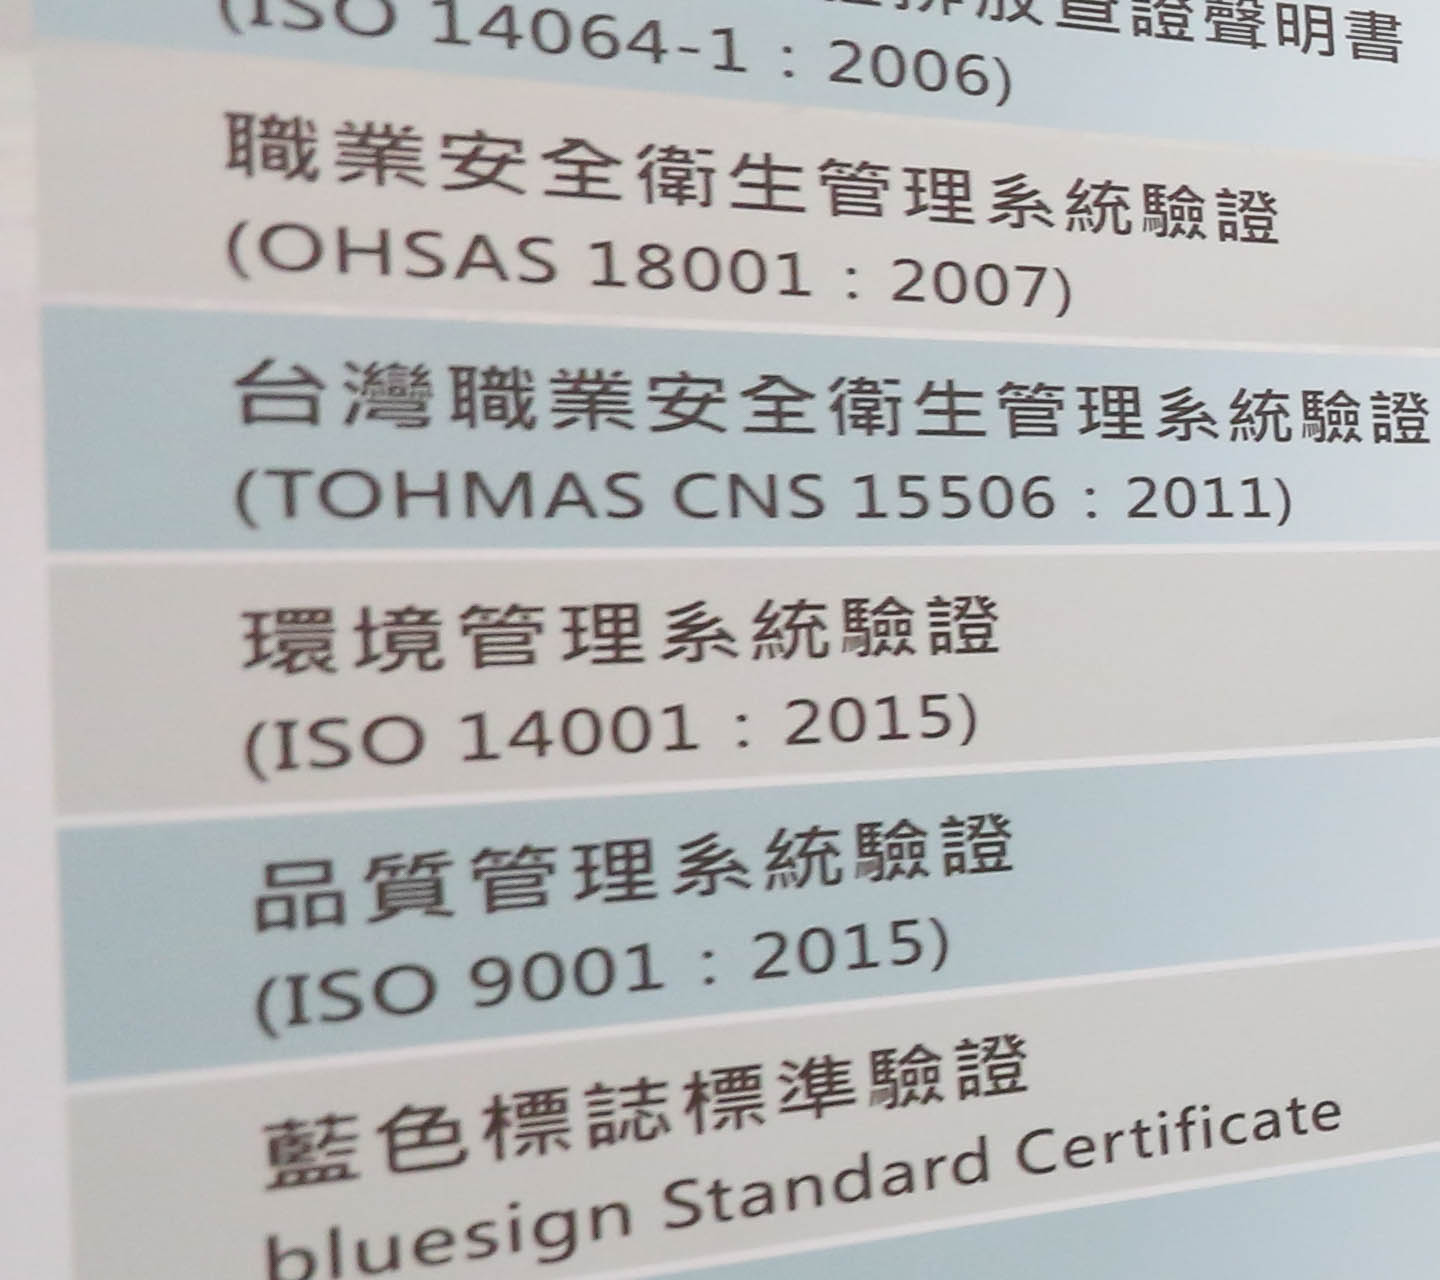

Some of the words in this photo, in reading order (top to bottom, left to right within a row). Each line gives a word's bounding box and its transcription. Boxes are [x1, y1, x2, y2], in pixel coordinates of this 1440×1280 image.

[224, 110, 1281, 246] 職業安全衛生管理系統驗證
[233, 358, 1432, 447] 台灣職業安全衛生管理系統驗證
[240, 594, 1000, 676] 環境管理系統驗證
[253, 812, 1014, 933] 品質管理系統驗證
[262, 1032, 1029, 1193] 藍色標誌標準驗證
[663, 1135, 990, 1232] Standard
[1016, 1093, 1343, 1175] Certificate
